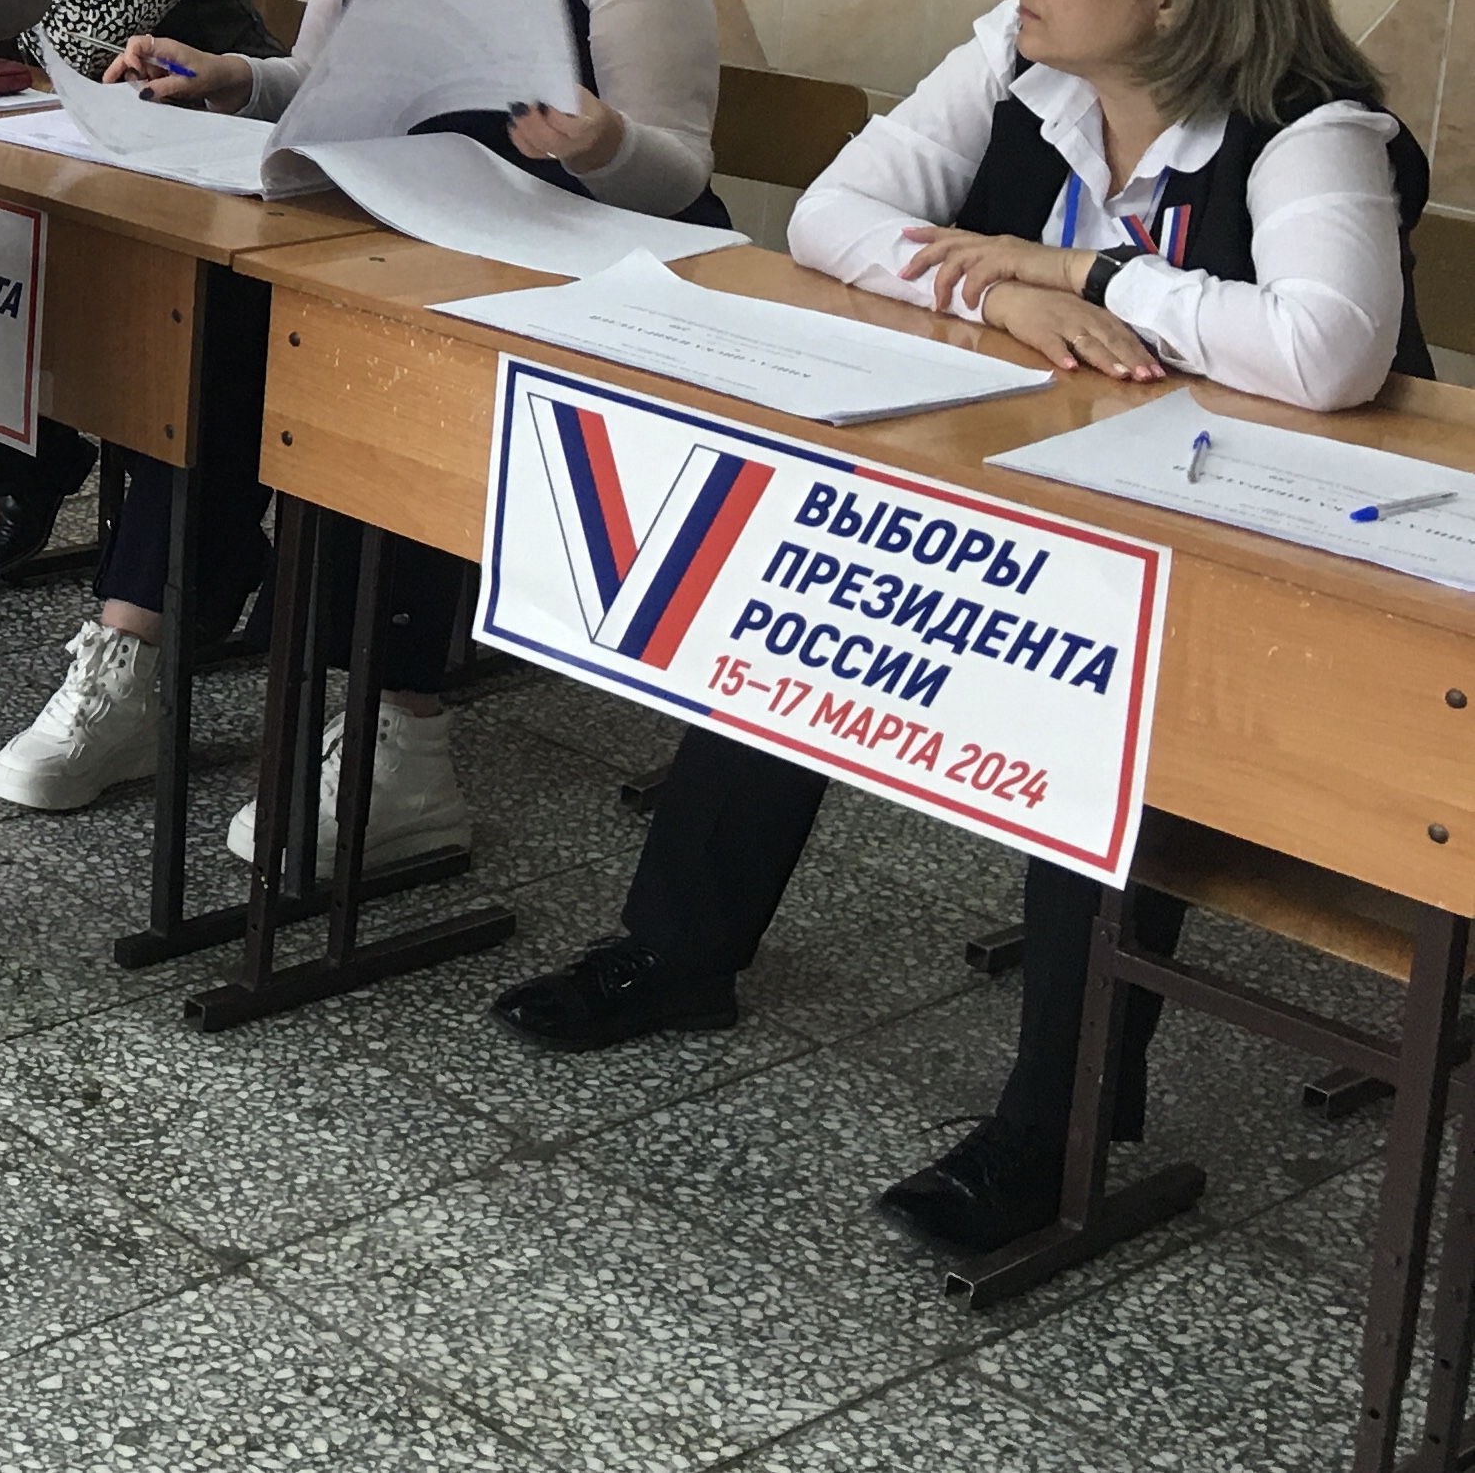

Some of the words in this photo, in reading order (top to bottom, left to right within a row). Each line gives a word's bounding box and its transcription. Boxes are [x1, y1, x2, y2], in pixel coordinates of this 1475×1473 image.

[793, 481, 1050, 594] ВЫБОРЫ
[729, 598, 952, 708] РОССИИ
[762, 540, 1119, 695] ПРЕЗИДЕНТА
[808, 692, 945, 772] МАРТА
[944, 743, 1050, 809] 2024
